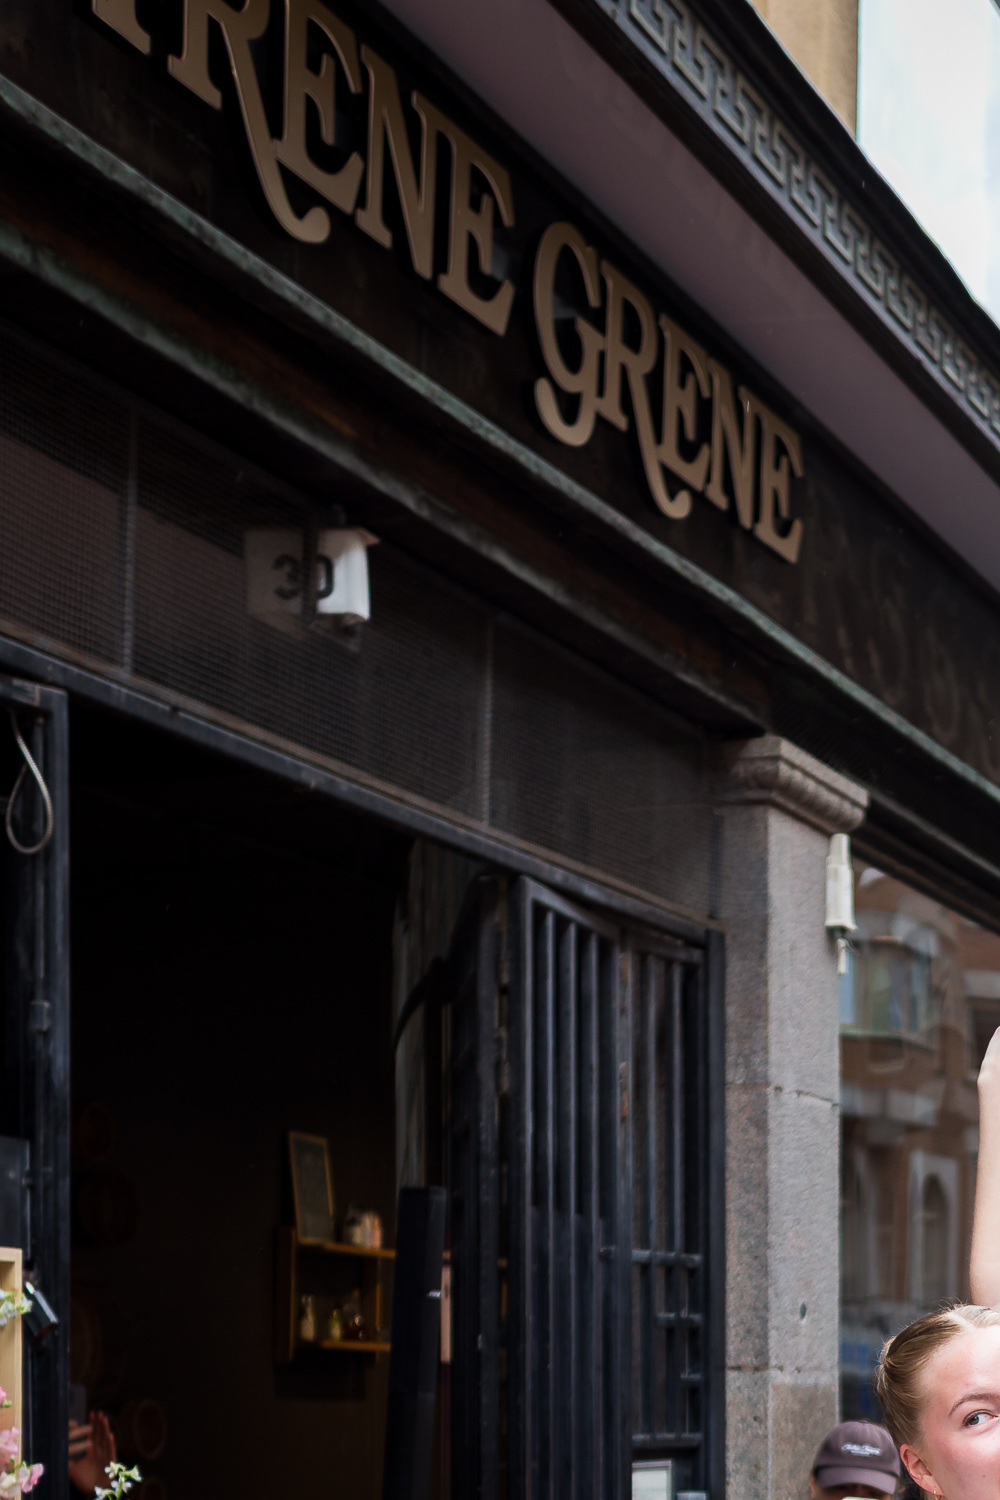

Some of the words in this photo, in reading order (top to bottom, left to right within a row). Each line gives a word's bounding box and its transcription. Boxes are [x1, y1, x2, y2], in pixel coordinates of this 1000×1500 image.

[93, 0, 515, 336] RENE
[534, 221, 803, 563] GRENE
[272, 553, 335, 600] 30
